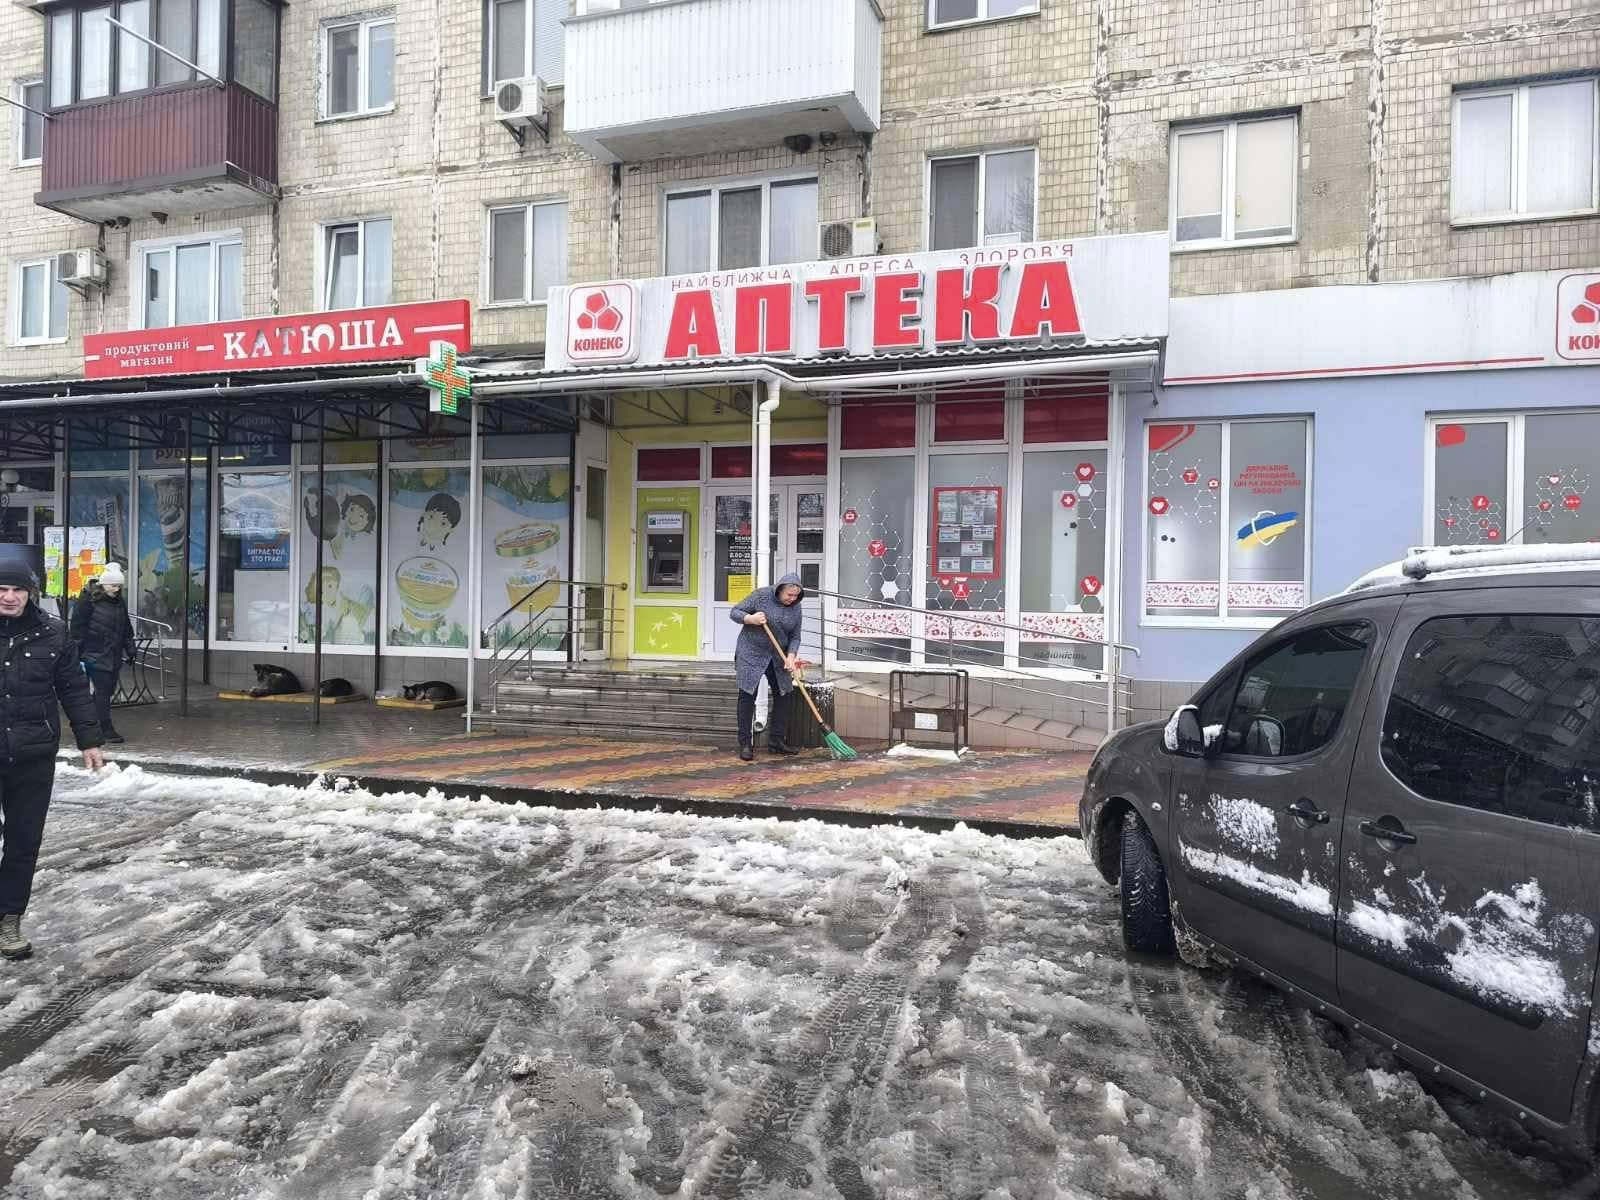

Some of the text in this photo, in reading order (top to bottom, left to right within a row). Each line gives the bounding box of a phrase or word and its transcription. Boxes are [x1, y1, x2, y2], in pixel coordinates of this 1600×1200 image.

[671, 269, 792, 291] НАЙБЛИЖЧА
[663, 259, 1083, 360] АПТЕКА
[104, 336, 190, 358] продуктовий
[223, 317, 404, 361] КАТЮША
[574, 337, 624, 352] КОНЕКС
[120, 354, 174, 368] магазин
